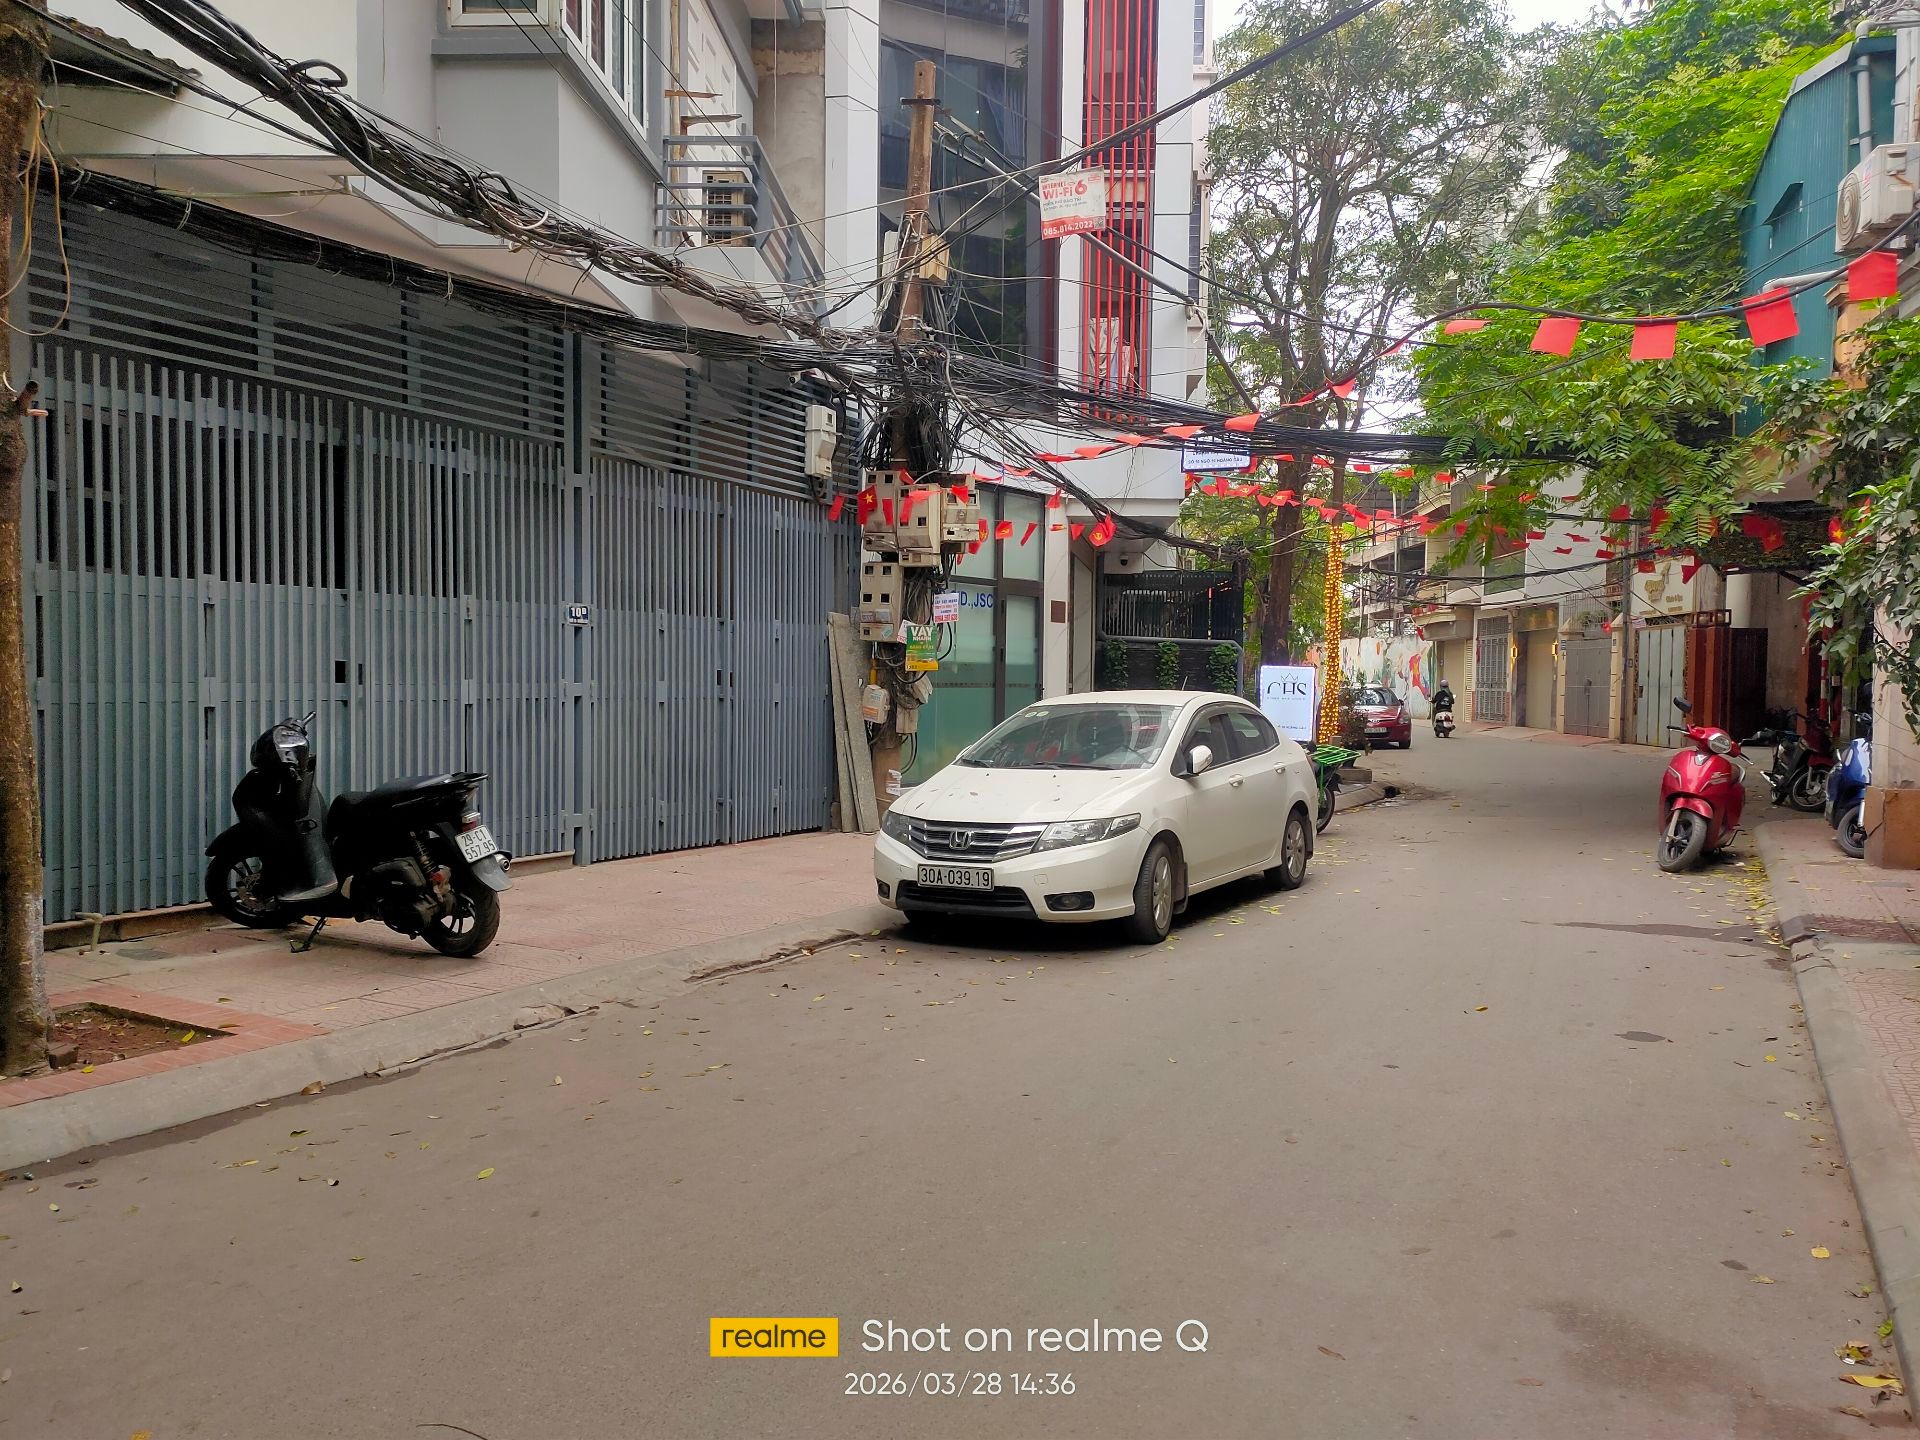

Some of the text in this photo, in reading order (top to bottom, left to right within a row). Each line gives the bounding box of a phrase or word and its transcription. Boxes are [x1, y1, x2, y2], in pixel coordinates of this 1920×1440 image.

[911, 625, 933, 637] VAY
[462, 829, 487, 847] 29-C1
[465, 840, 496, 860] 557.95
[920, 867, 990, 887] 30A-039.19
